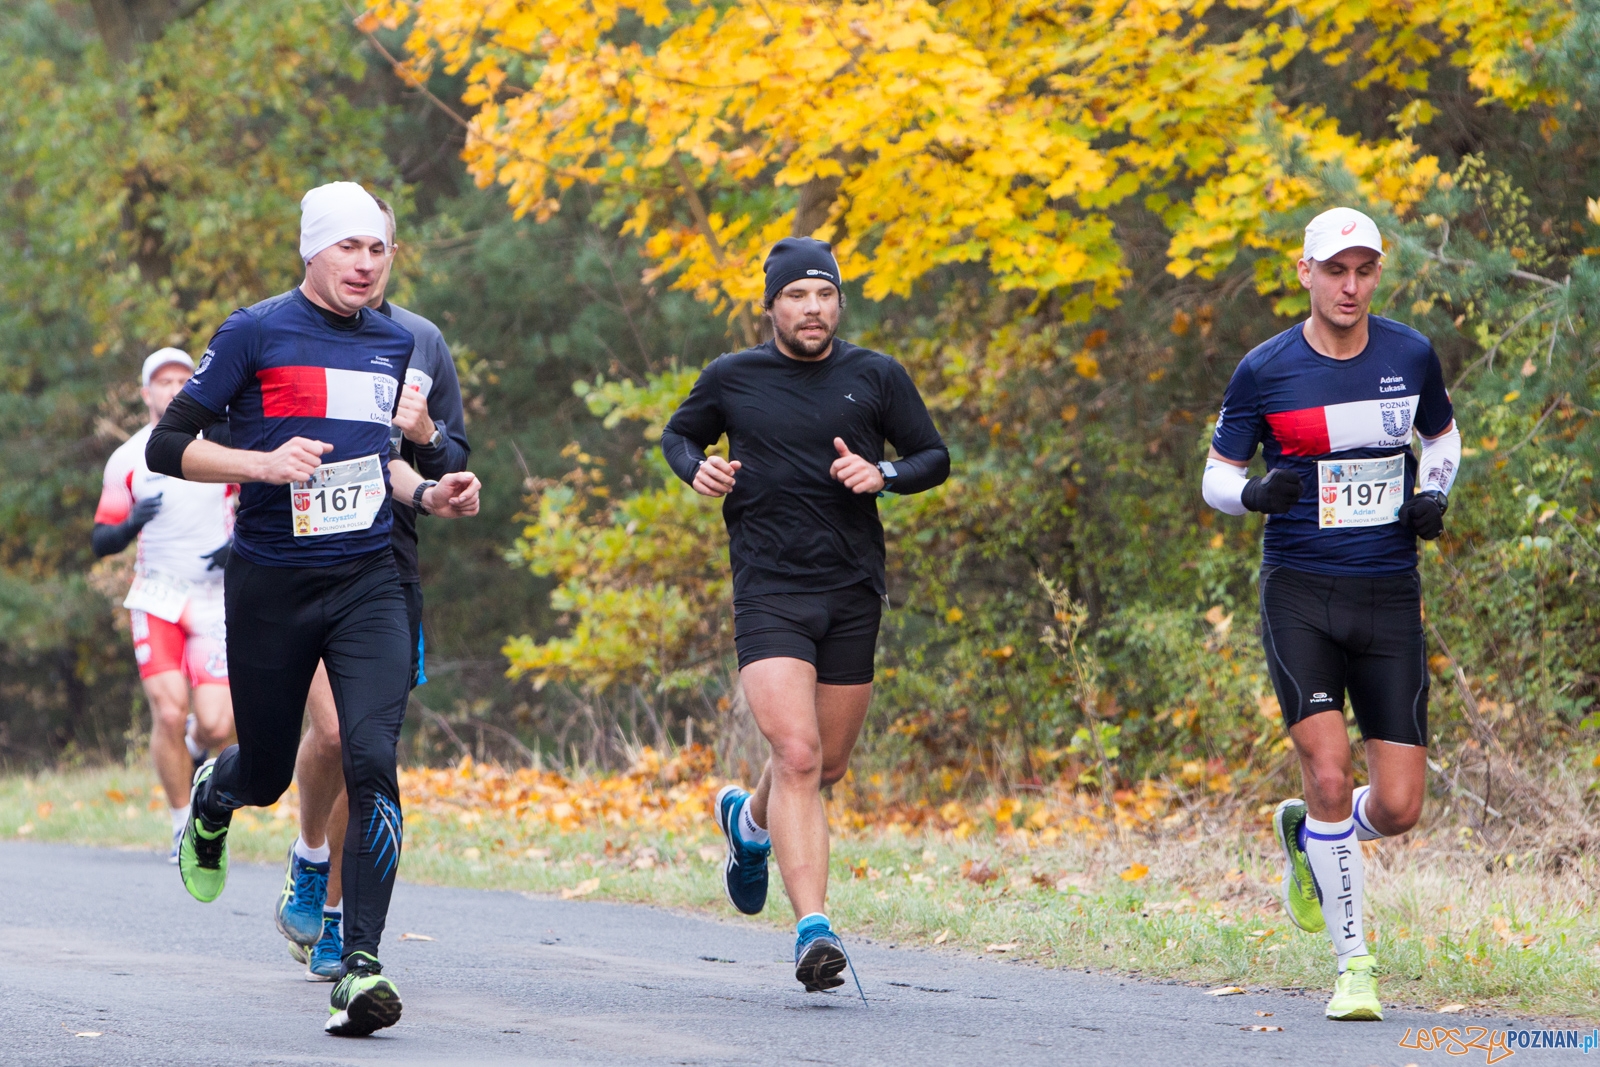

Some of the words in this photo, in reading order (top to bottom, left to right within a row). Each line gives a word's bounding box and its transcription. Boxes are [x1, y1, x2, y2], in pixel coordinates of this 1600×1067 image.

[1380, 376, 1404, 384] Adrian
[1379, 383, 1407, 393] Łukasik
[315, 484, 362, 513] 167
[1341, 482, 1388, 506] 197
[323, 512, 357, 524] Krzysztof
[1352, 508, 1376, 516] Adrian
[1331, 845, 1356, 939] Kalenji
